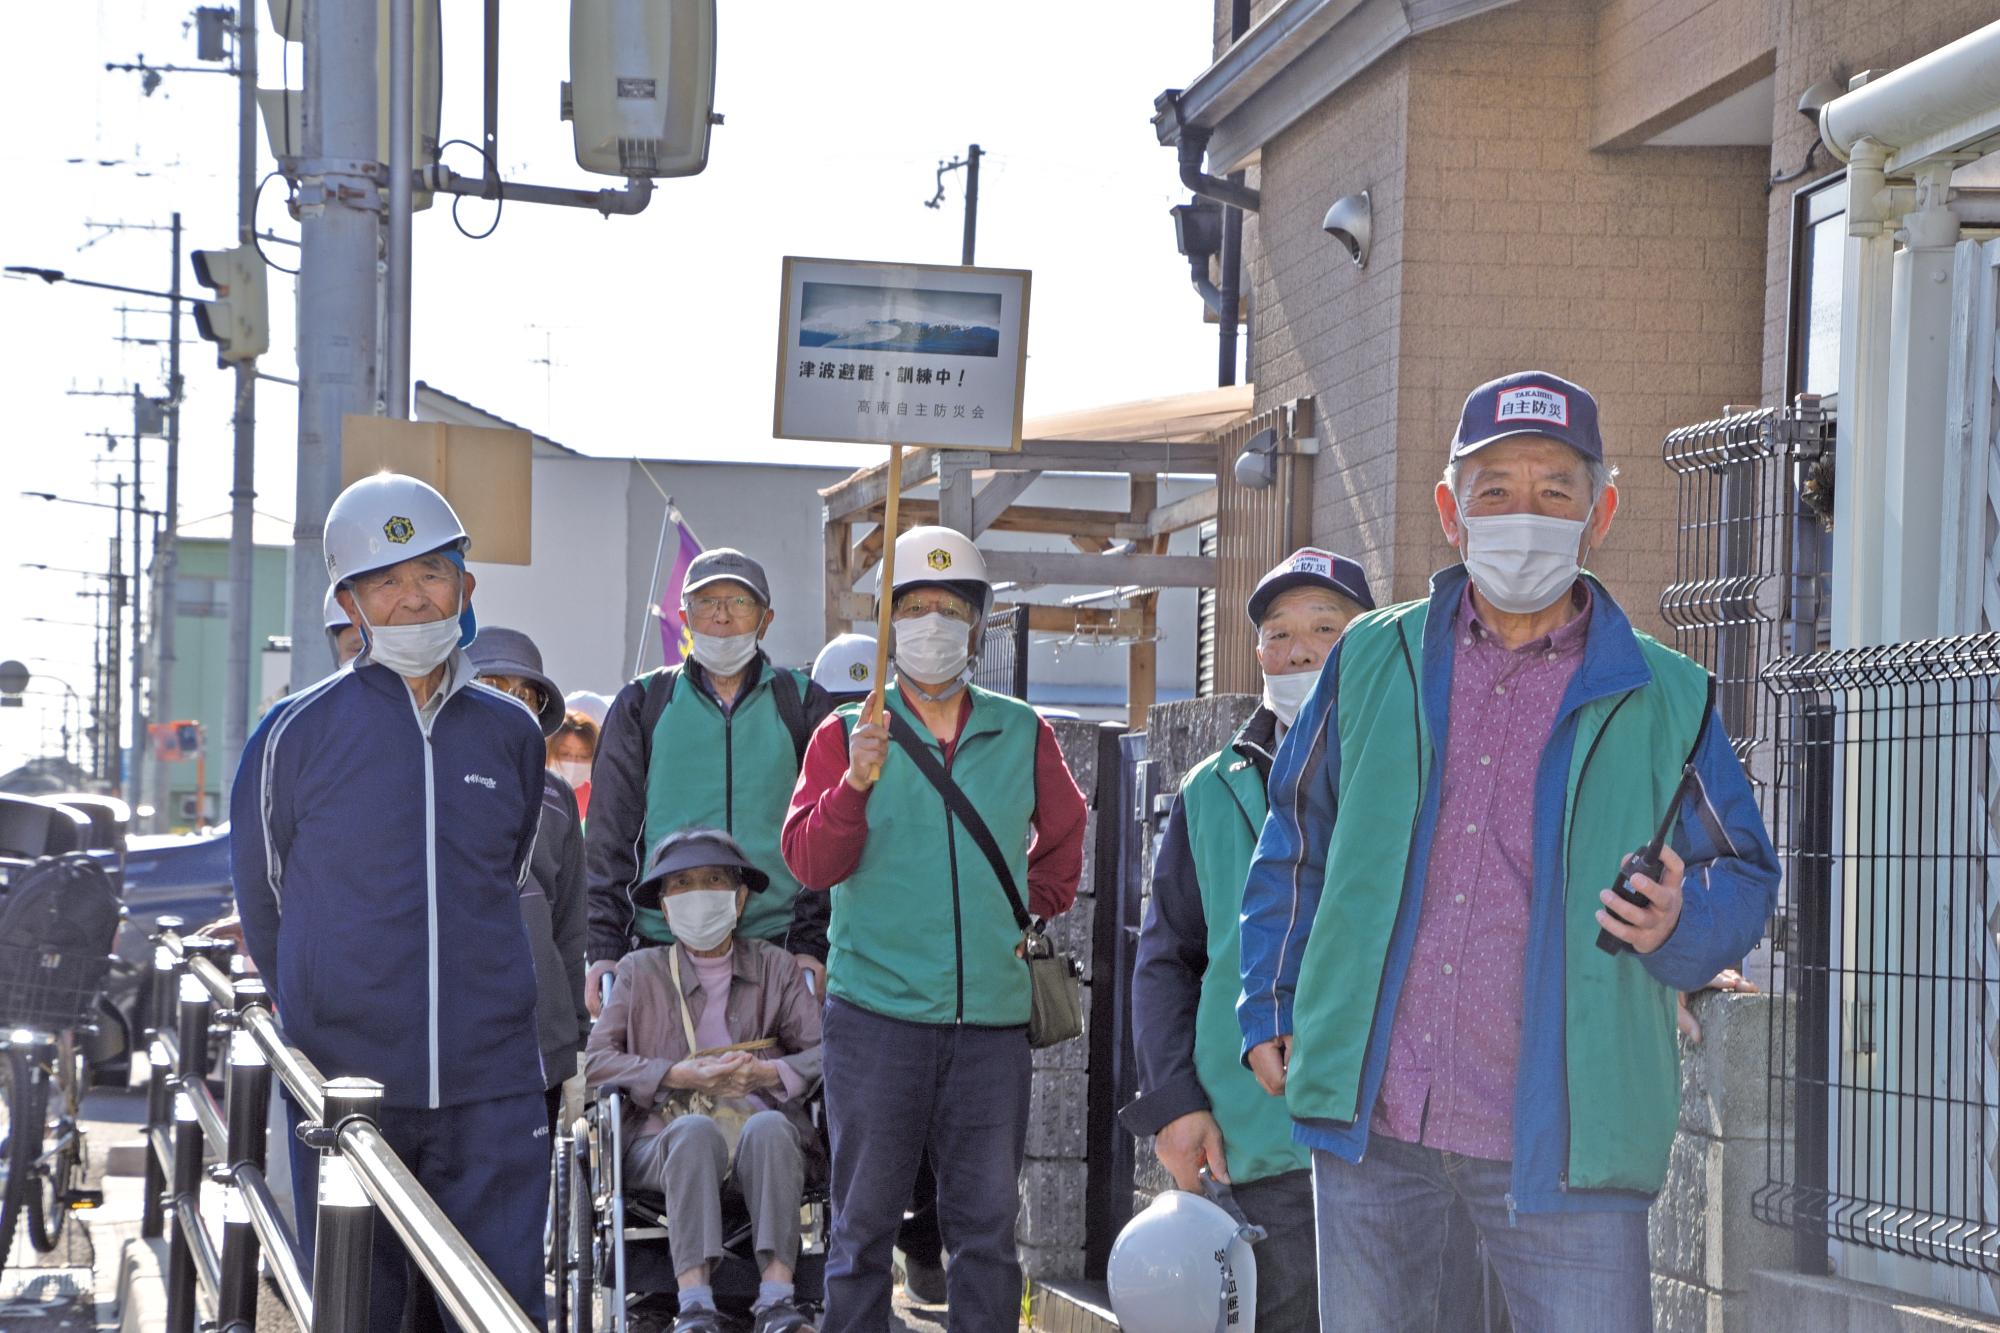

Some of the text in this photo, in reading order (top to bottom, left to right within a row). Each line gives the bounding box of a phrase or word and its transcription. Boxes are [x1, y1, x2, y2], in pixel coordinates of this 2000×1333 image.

[799, 361, 965, 387] 津波避難・訓練中！
[857, 400, 985, 419] 高南自主防災会
[1502, 400, 1562, 419] 自主防災
